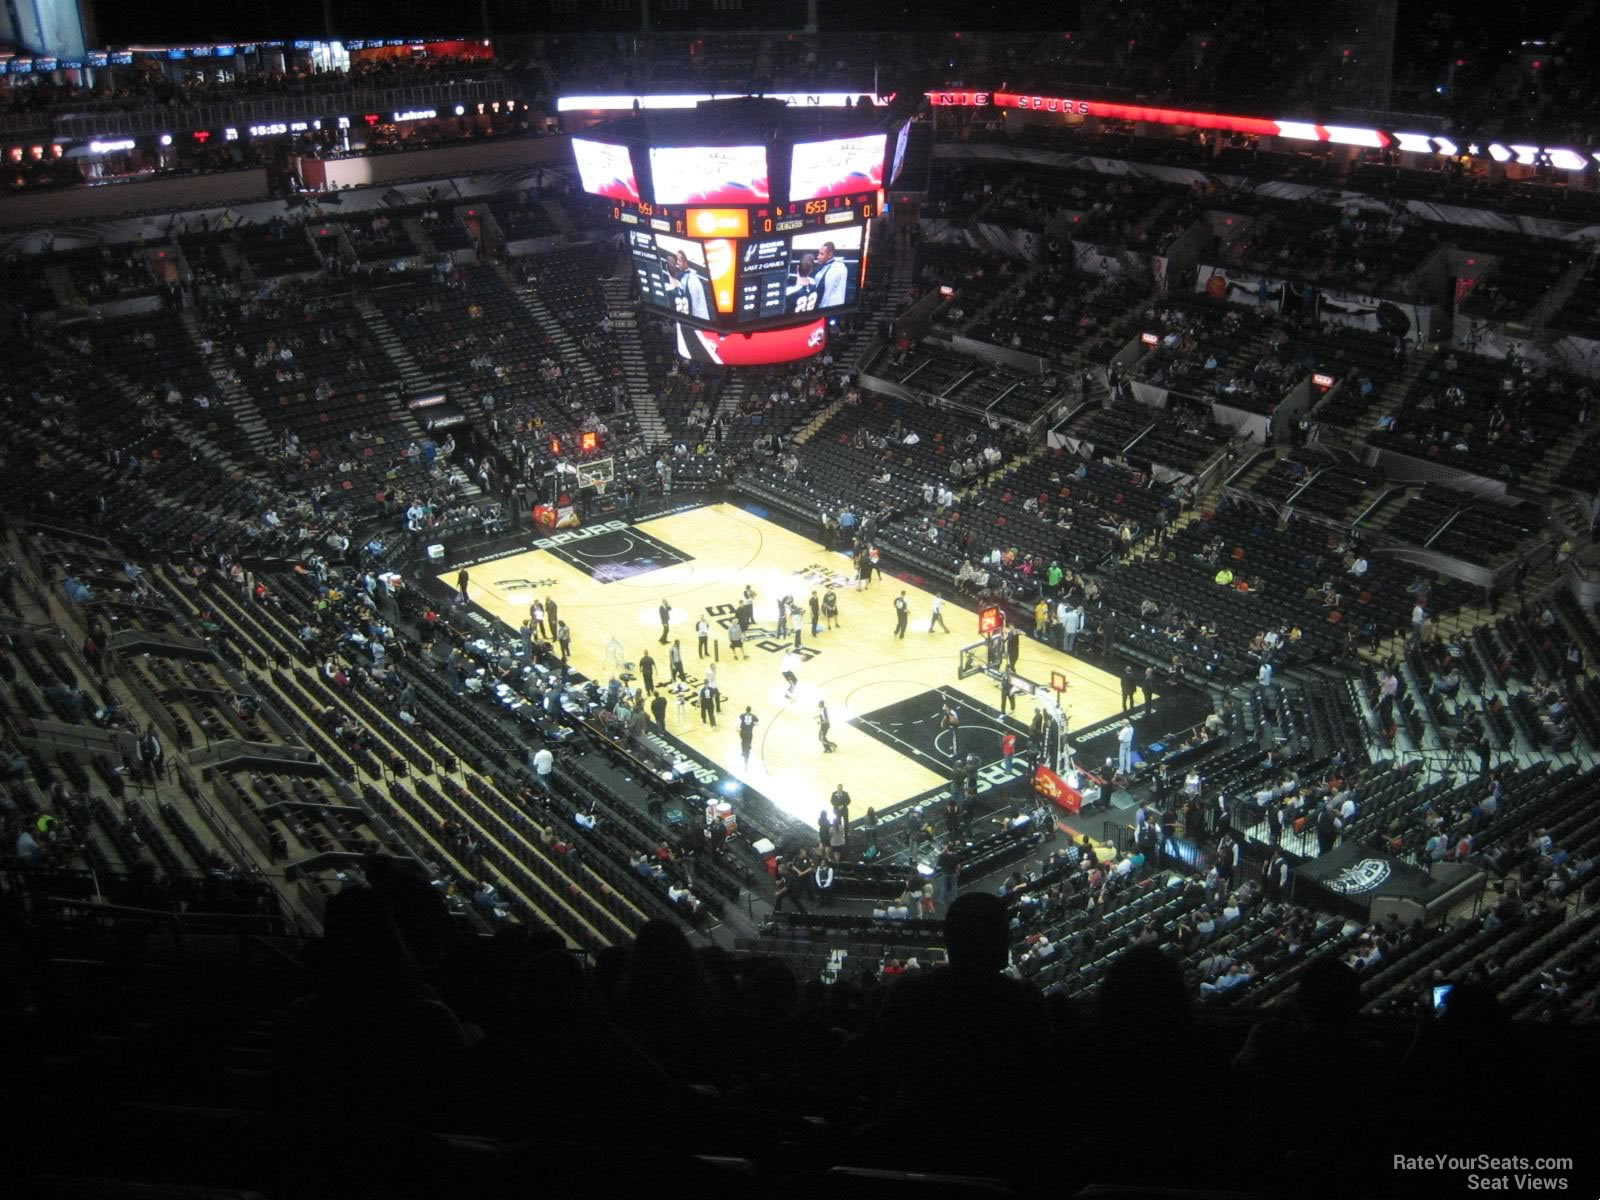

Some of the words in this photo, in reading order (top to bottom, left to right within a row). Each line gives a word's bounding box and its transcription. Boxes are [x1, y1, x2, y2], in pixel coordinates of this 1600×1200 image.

[1018, 95, 1089, 114] SPURS
[394, 109, 437, 122] Lakers
[250, 123, 287, 137] 15:53
[532, 519, 630, 549] SPURS
